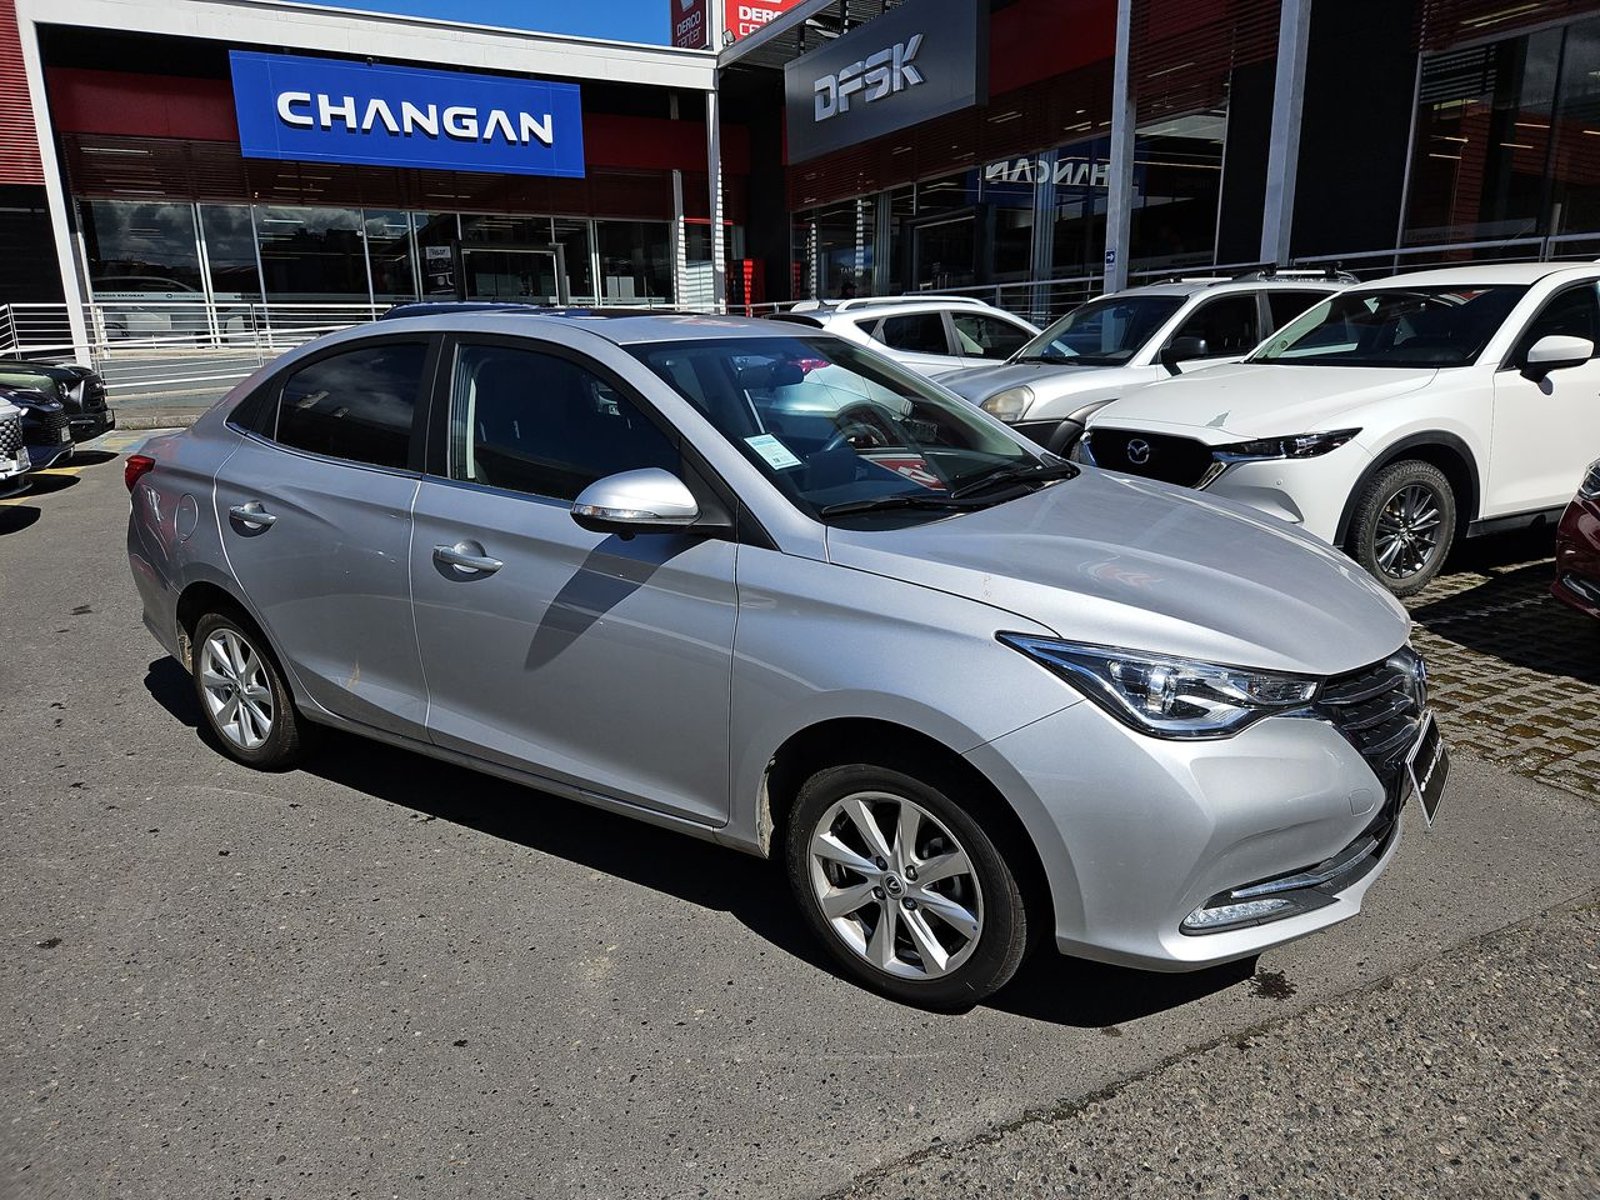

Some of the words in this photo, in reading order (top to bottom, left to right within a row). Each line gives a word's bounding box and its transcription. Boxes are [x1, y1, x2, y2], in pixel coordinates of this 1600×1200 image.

[676, 10, 701, 37] DERCO
[814, 33, 923, 122] DFSK
[277, 91, 554, 144] CHANGAN
